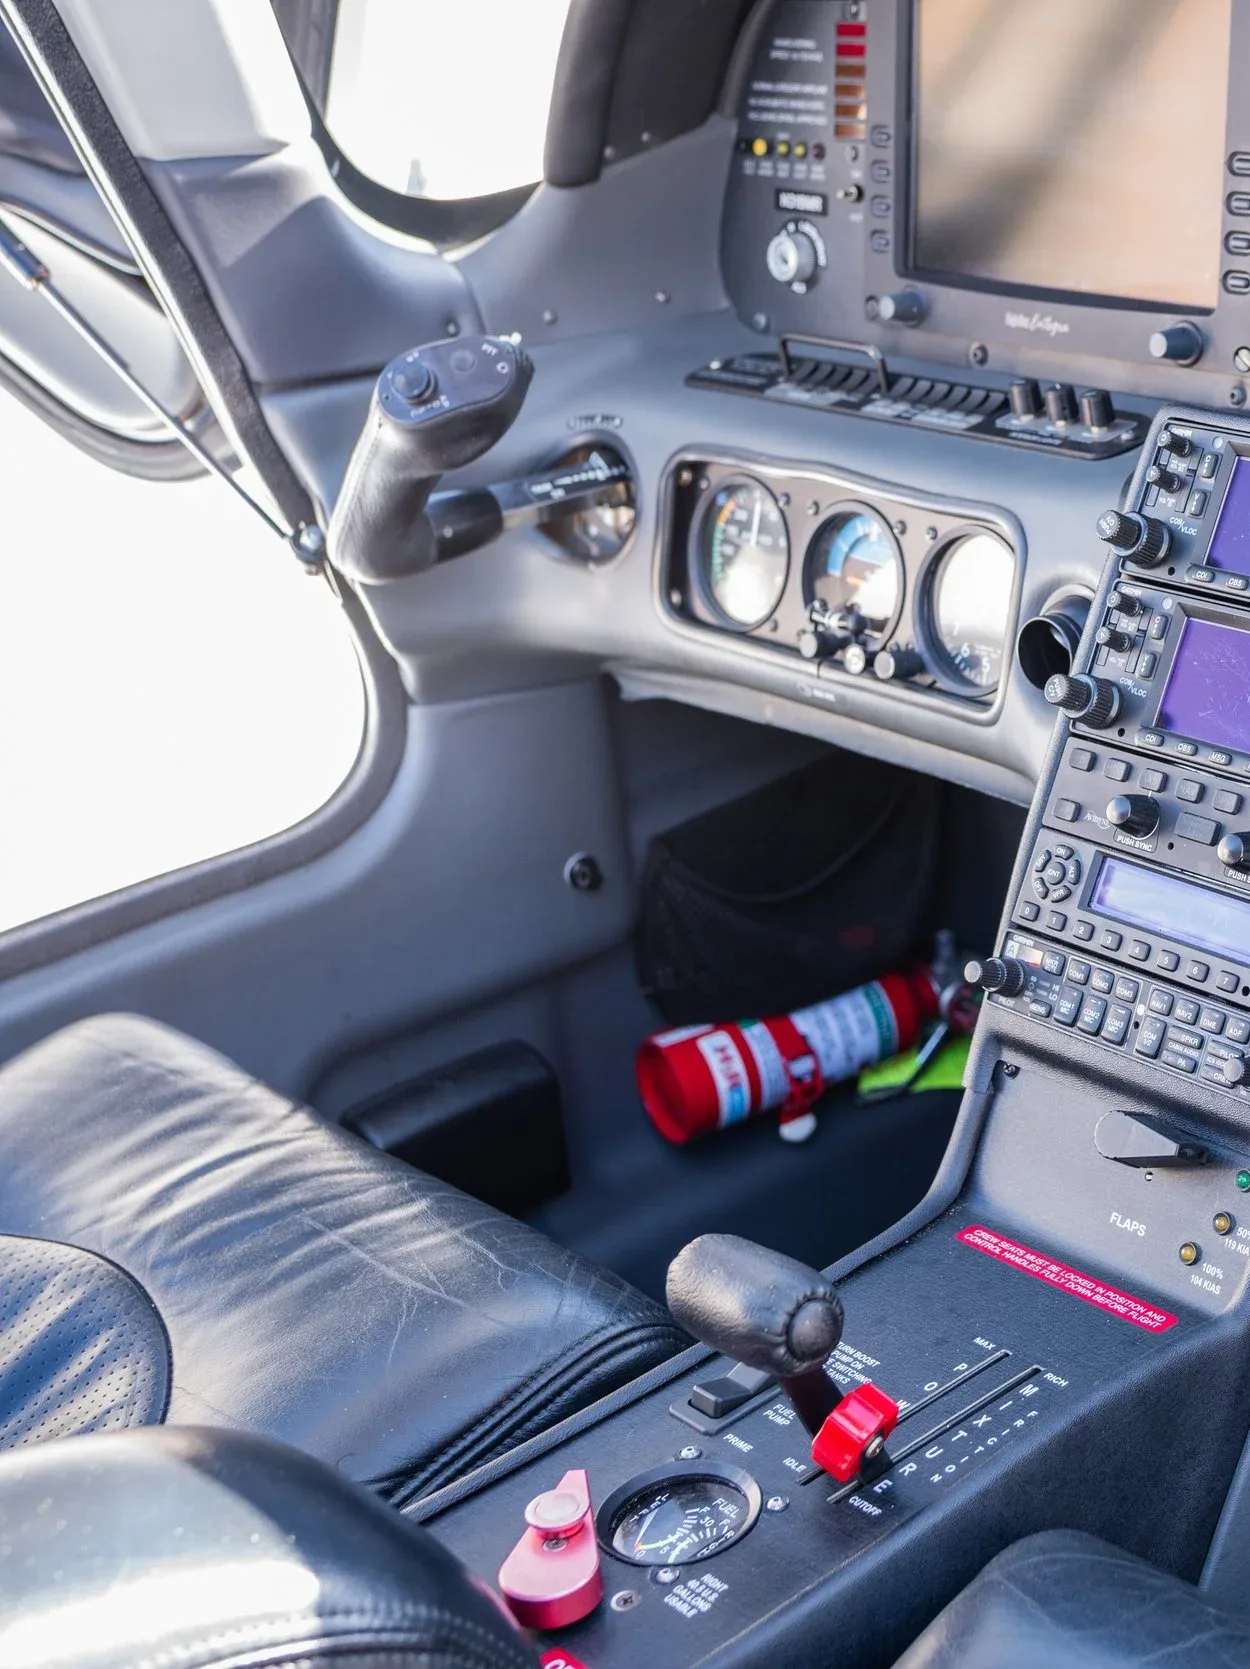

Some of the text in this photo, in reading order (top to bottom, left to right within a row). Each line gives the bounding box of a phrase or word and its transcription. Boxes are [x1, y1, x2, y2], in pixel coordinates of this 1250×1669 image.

[1169, 516, 1198, 536] COM/VLOC
[1228, 577, 1242, 587] OBS
[1122, 586, 1143, 596] GARMIN
[1119, 677, 1147, 698] COM/VLOC
[1145, 734, 1157, 743] CDI
[1178, 743, 1192, 753] OBS
[1211, 752, 1226, 763] MSG
[1180, 784, 1196, 796] NAV
[1117, 834, 1153, 851] PUSH SYNC
[1056, 847, 1066, 856] ON
[1228, 869, 1246, 882] PUSH
[1033, 880, 1043, 894] OFF
[1052, 889, 1065, 899] VFR
[1024, 907, 1030, 915] 0
[1078, 926, 1084, 935] 2
[1106, 936, 1112, 944] 3
[1134, 946, 1140, 954] 4
[1163, 956, 1169, 964] 5
[1069, 970, 1084, 980] COM1
[1192, 966, 1199, 976] 6
[1092, 978, 1109, 989] COM2
[1223, 976, 1230, 986] 7
[1049, 993, 1058, 1001] LO
[1117, 987, 1133, 997] COM3
[999, 998, 1015, 1008] PILOT
[1060, 1000, 1075, 1010] COM1
[1152, 999, 1166, 1010] NAV1
[1060, 1007, 1070, 1015] MIC
[1084, 1008, 1100, 1019] COM2
[1176, 1008, 1193, 1019] NAV2
[1084, 1016, 1094, 1024] MIC
[1108, 1017, 1124, 1029] COM3
[1203, 1018, 1217, 1029] DME
[1108, 1025, 1119, 1033] MIC
[1228, 1025, 1243, 1037] ADF
[1143, 1031, 1157, 1041] COM
[1181, 1033, 1199, 1046] SPKR
[1183, 1047, 1199, 1057] AUDIO
[1177, 1058, 1186, 1067] PA
[1110, 1212, 1147, 1237] FLAPS
[1224, 1237, 1237, 1250] 119
[973, 1229, 1167, 1323] CREW SEATS MUST BE LOCKED IN POSITION AND
[1202, 1262, 1224, 1280] 100%
[963, 1233, 1162, 1329] CONTROL HANDLES FULLY DOWN BEFORE FLIGHT
[1190, 1274, 1221, 1295] 104 KIAS
[973, 1337, 996, 1350] MAX
[831, 1350, 854, 1365] PUMP
[850, 1360, 865, 1370] ON
[836, 1341, 856, 1356] TURN
[853, 1350, 881, 1368] BOOST
[826, 1368, 851, 1385] TANKS
[832, 1361, 873, 1385] SWITCHING
[1043, 1372, 1069, 1387] RICH
[772, 1403, 797, 1420] FUEL
[763, 1409, 791, 1427] PUMP
[722, 1433, 754, 1453] PRIME
[782, 1456, 807, 1473] IDLE
[712, 1497, 741, 1519] FUEL
[848, 1495, 882, 1516] CUTOFF
[700, 1516, 714, 1528] 30
[700, 1573, 729, 1592] RIGHT
[672, 1584, 712, 1612] GALLONS
[664, 1594, 698, 1619] USABLE
